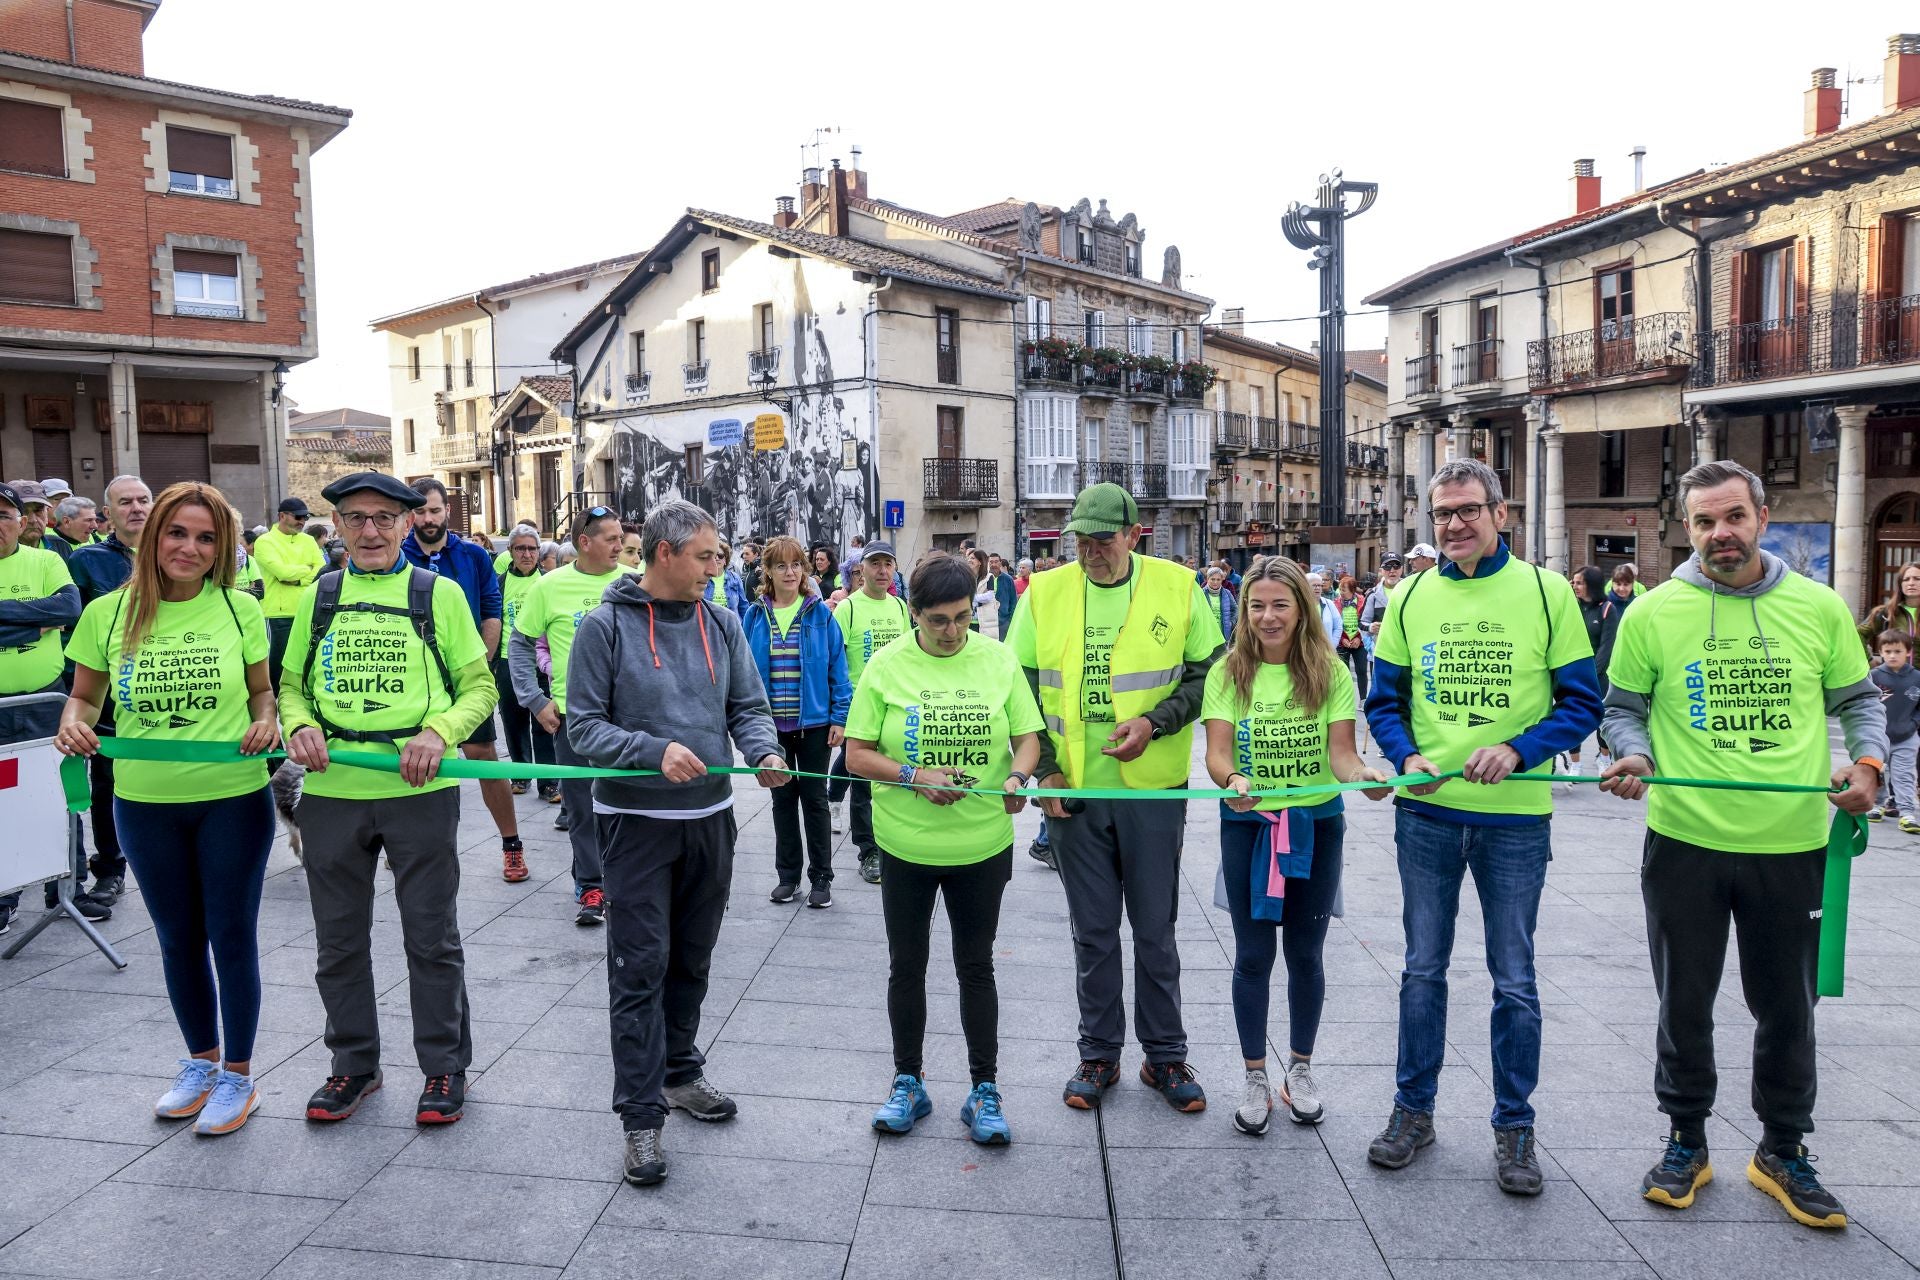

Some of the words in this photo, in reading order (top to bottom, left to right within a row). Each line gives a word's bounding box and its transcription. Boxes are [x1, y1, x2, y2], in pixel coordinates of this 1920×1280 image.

[337, 637, 349, 647] el
[355, 636, 407, 648] cáncer
[337, 649, 406, 662] martxan
[1086, 650, 1099, 661] el
[1440, 648, 1454, 659] el
[1458, 647, 1513, 660] cáncer
[139, 657, 155, 668] el
[160, 655, 219, 667] cáncer
[322, 632, 335, 693] ARABA
[1439, 660, 1512, 674] martxan
[1721, 657, 1757, 665] marcha
[336, 663, 406, 673] minbiziaren
[1422, 642, 1437, 704] ARABA
[1708, 667, 1725, 679] el
[1730, 666, 1791, 679] cáncer
[137, 668, 220, 682] martxan
[1439, 675, 1511, 686] minbiziaren
[118, 653, 137, 712] ARABA
[136, 682, 221, 694] minbiziaren
[337, 674, 404, 693] aurka
[1710, 680, 1791, 694] martxan
[139, 692, 217, 712] aurka
[1440, 687, 1510, 708] aurka
[1685, 661, 1707, 732] ARABA
[1711, 697, 1790, 708] minbiziaren
[924, 711, 937, 721] el
[941, 712, 990, 721] cáncer
[1294, 714, 1317, 722] contra
[1712, 709, 1792, 731] aurka
[904, 706, 919, 764] ARABA
[923, 723, 990, 735] martxan
[1254, 726, 1267, 736] el
[1271, 723, 1319, 736] cáncer
[923, 737, 990, 746] minbiziaren
[1238, 719, 1253, 777] ARABA
[1255, 735, 1320, 748] martxan
[923, 748, 988, 766] aurka
[1256, 748, 1321, 759] minbiziaren
[1257, 760, 1320, 778] aurka
